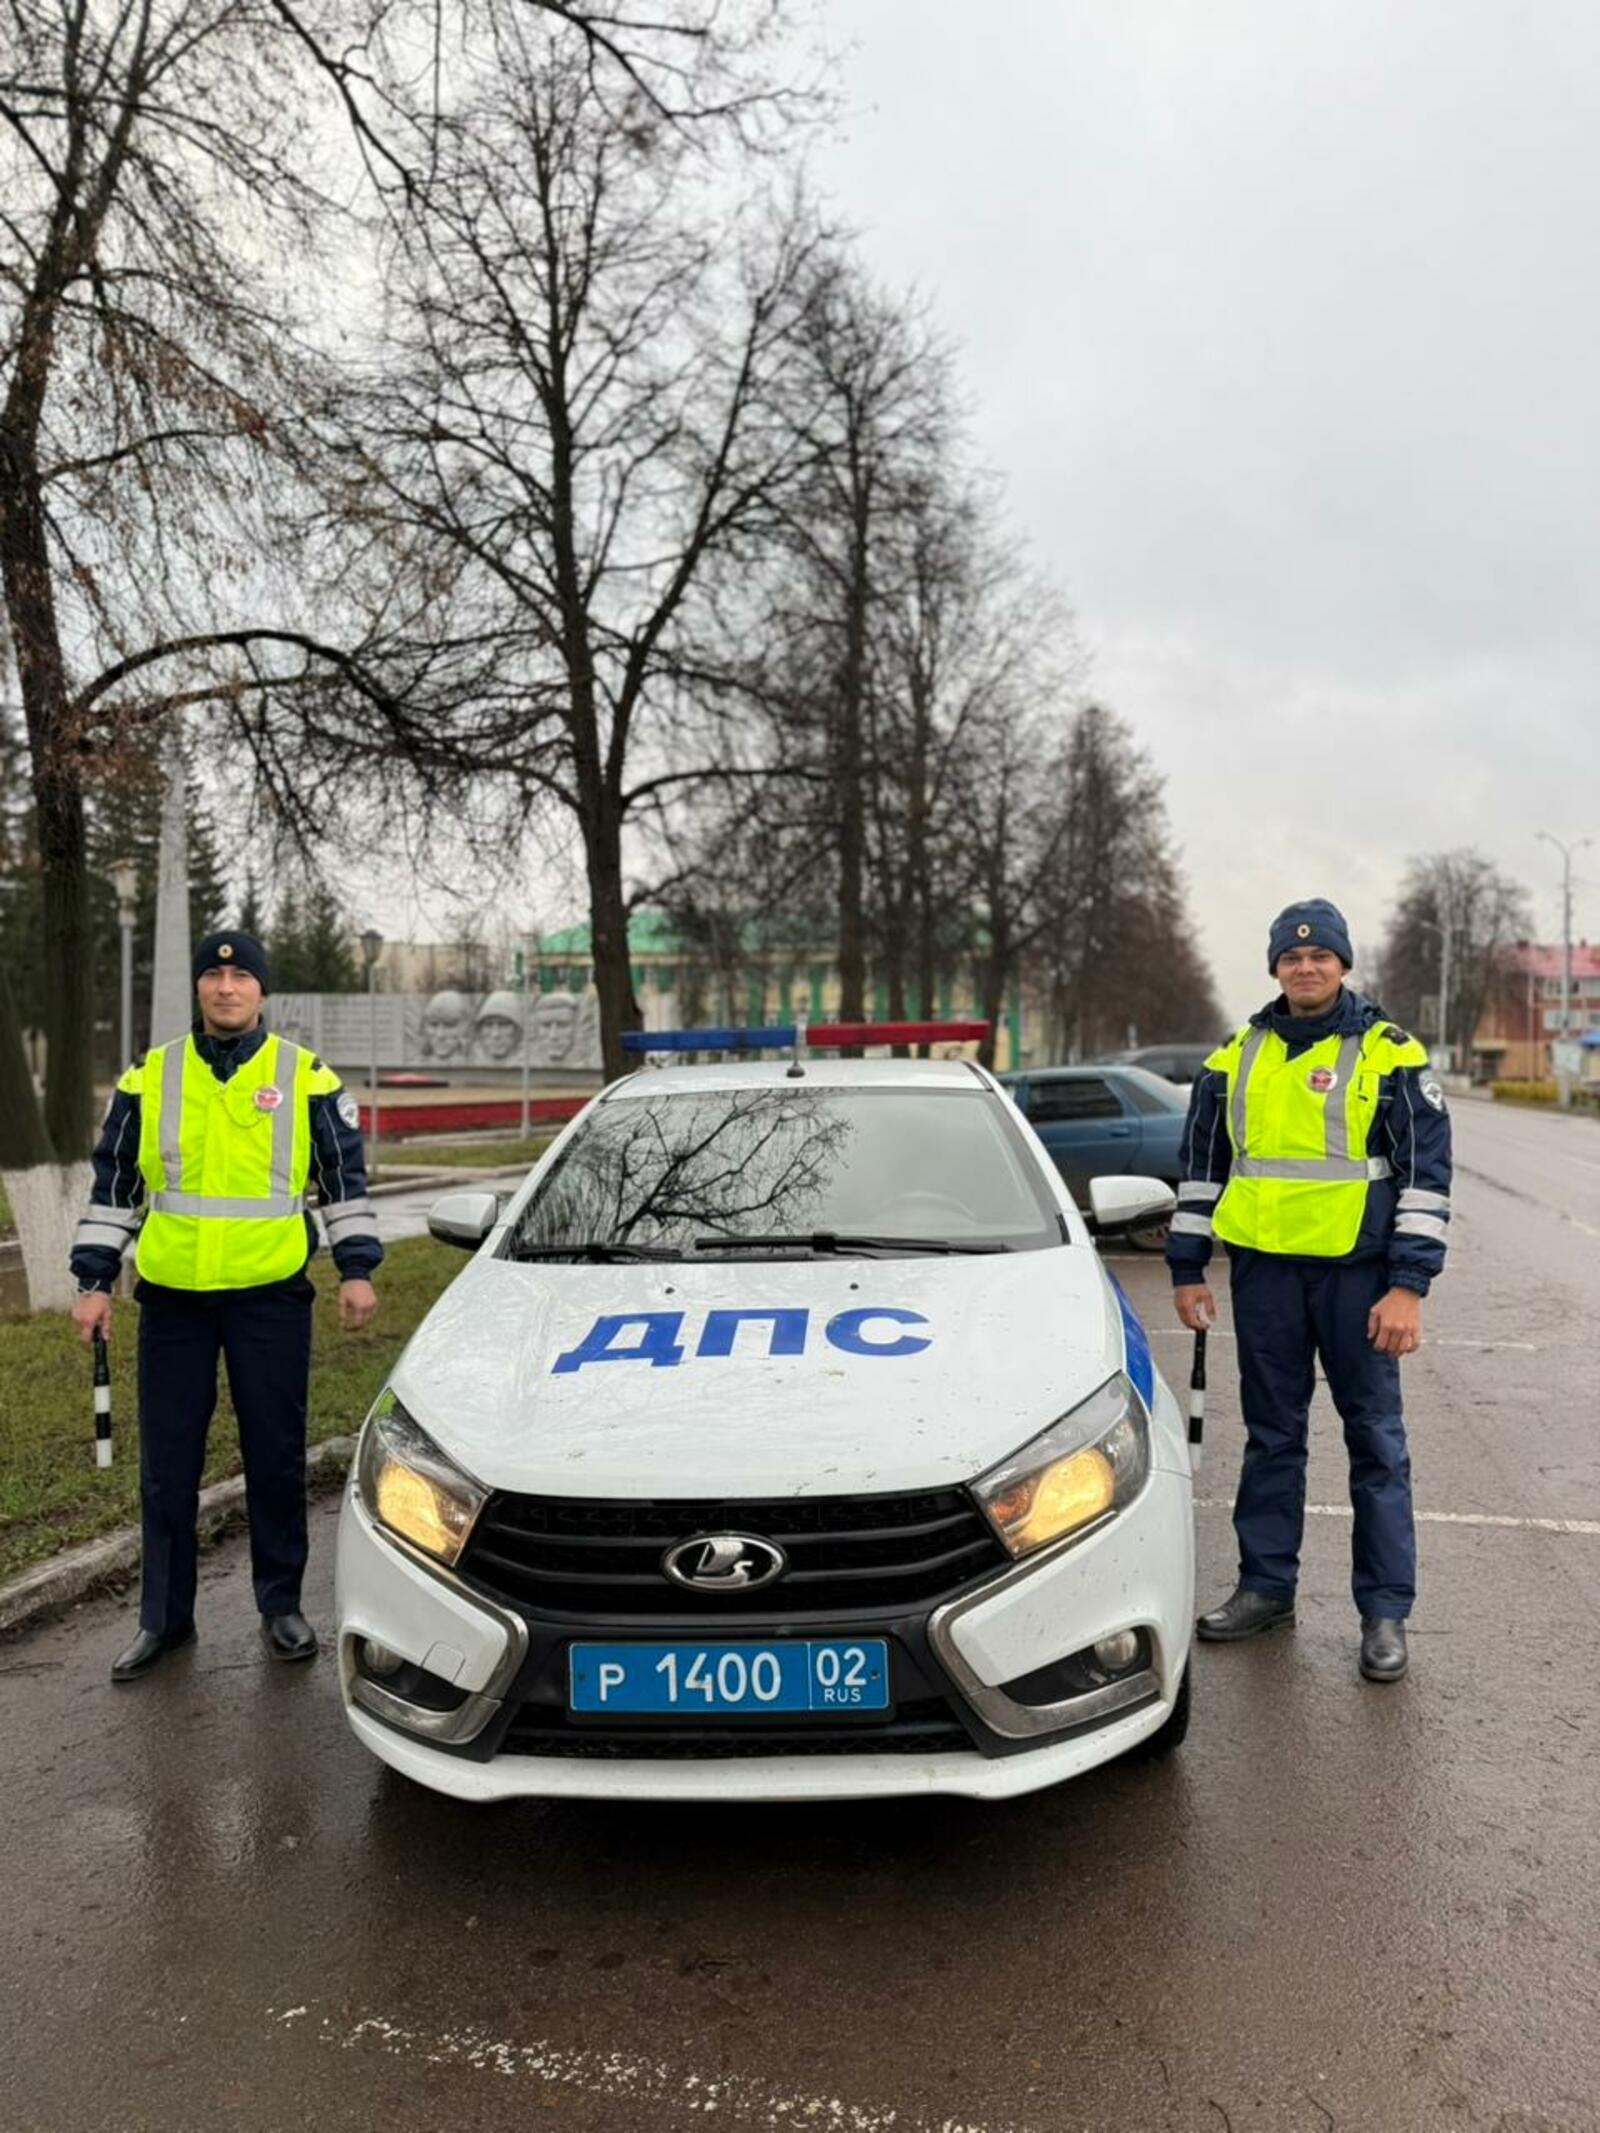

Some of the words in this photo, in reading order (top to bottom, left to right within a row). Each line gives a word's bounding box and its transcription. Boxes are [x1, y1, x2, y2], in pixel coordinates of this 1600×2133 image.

[551, 1307, 933, 1374] ДПС
[655, 1652, 781, 1702] 1400
[816, 1648, 867, 1687] 02
[824, 1688, 862, 1703] RUS
